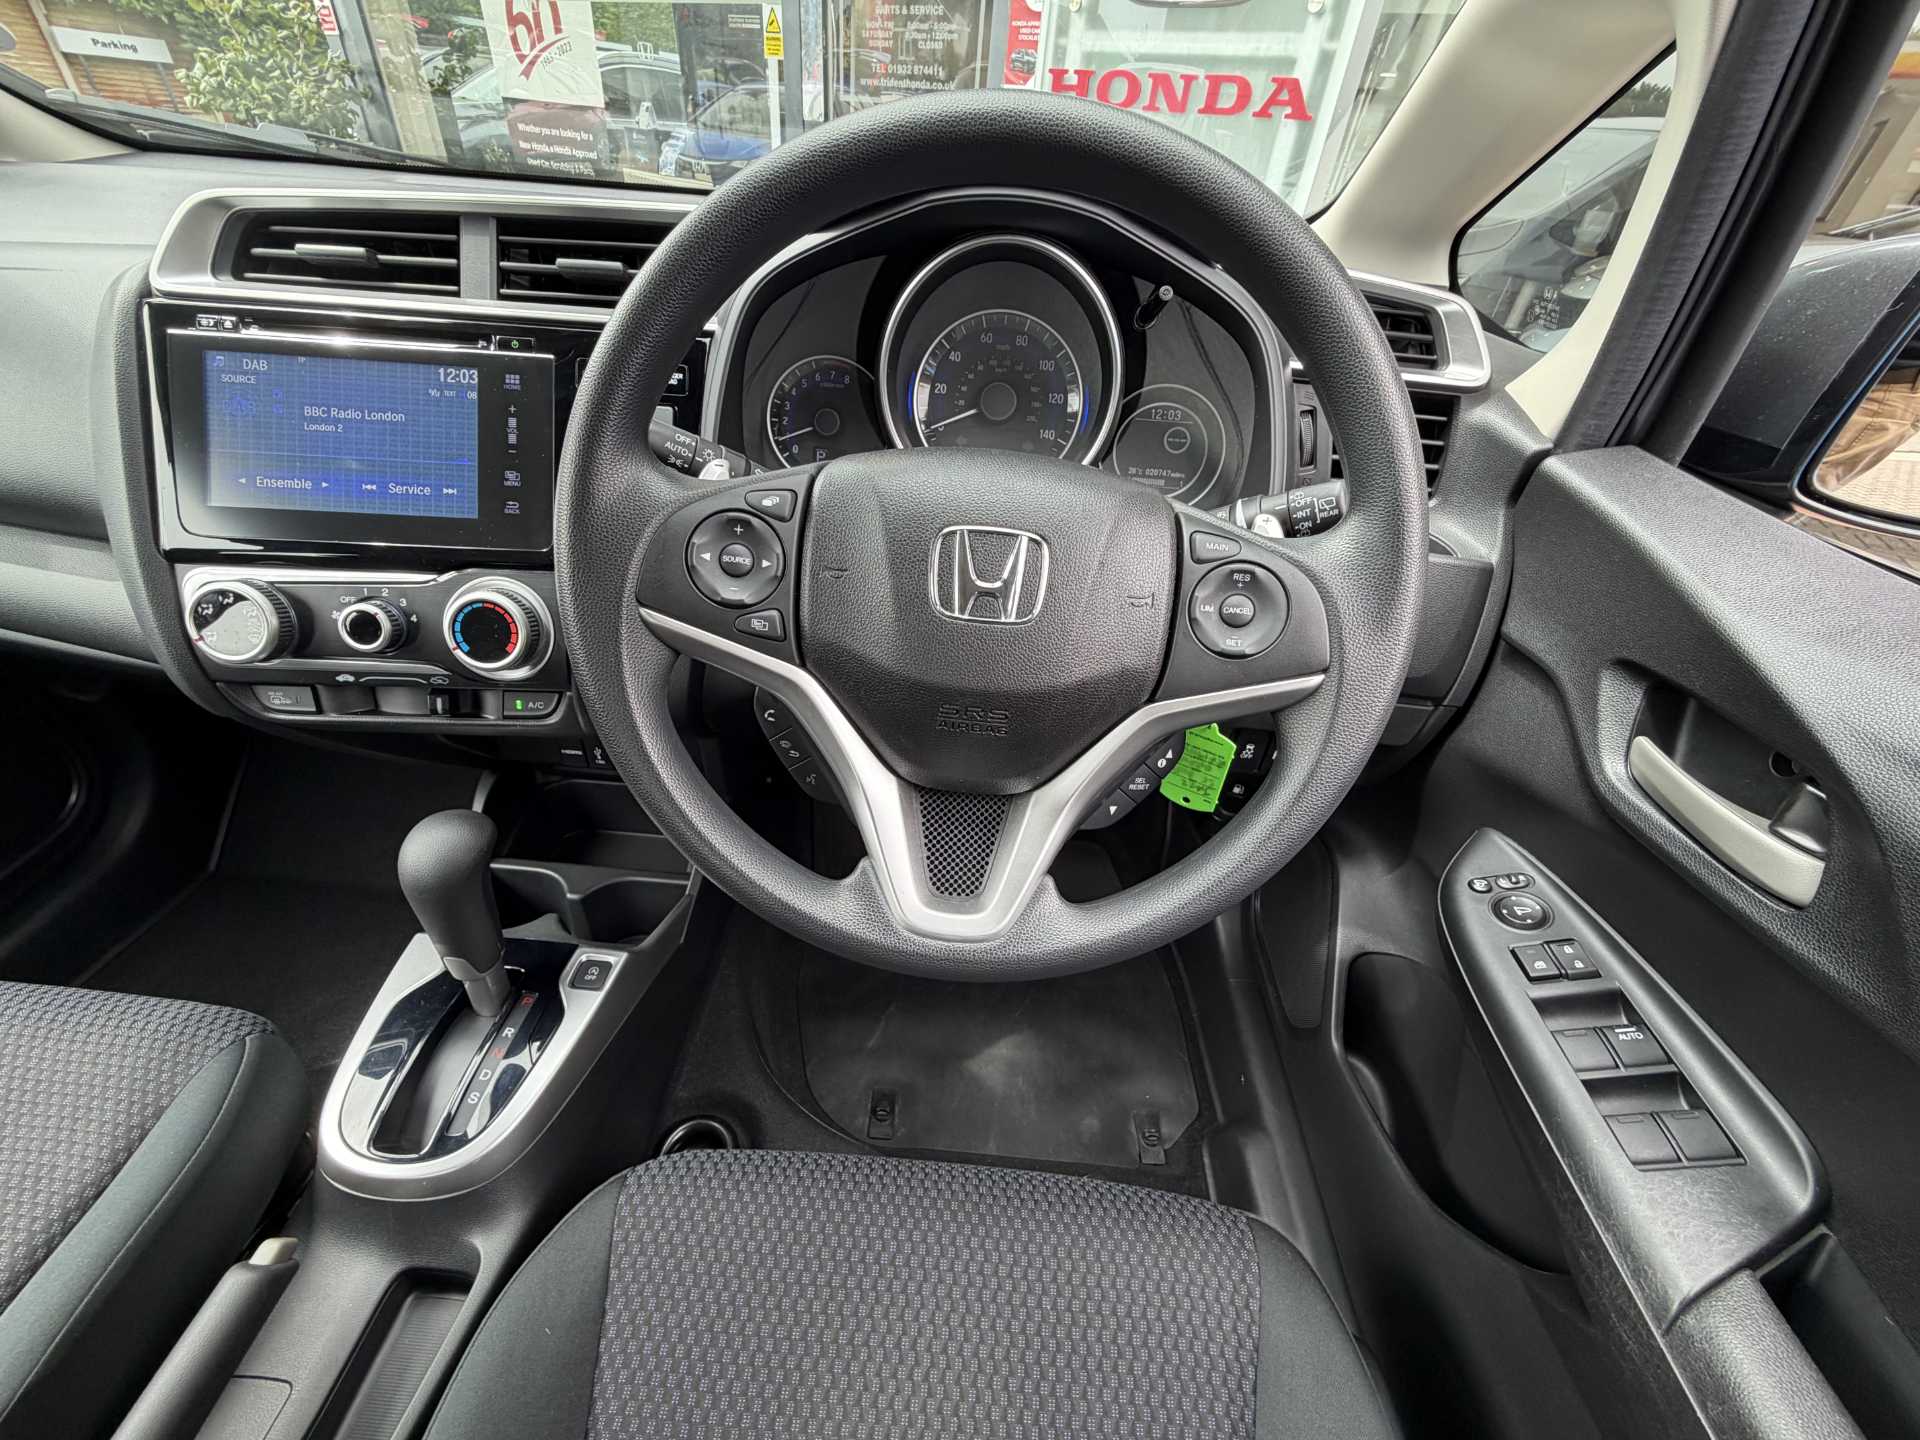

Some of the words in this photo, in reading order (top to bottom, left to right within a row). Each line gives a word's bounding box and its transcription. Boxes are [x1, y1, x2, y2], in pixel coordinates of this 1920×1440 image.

[875, 5, 900, 15] PARTS
[910, 4, 944, 16] SERVICE
[91, 37, 139, 53] Parking
[918, 41, 943, 49] CLOSED
[872, 63, 887, 73] TEL
[1048, 68, 1313, 122] HONDA
[560, 128, 580, 141] looking
[980, 333, 993, 344] 60
[1016, 336, 1028, 346] 80
[948, 351, 961, 362] 40
[242, 358, 269, 371] DAB
[1039, 360, 1055, 371] 100
[221, 373, 257, 385] SOURCE
[438, 367, 479, 384] 12:03
[935, 383, 947, 395] 20
[467, 391, 478, 400] 08
[1048, 393, 1064, 405] 120
[785, 401, 791, 410] 3
[304, 406, 328, 418] BBC
[330, 408, 362, 420] Radio
[365, 410, 406, 423] London
[1151, 408, 1182, 421] 12:03
[782, 416, 789, 425] 2
[304, 422, 336, 432] London
[337, 424, 344, 433] 2
[674, 433, 692, 445] OFF
[1039, 429, 1056, 441] 140
[664, 440, 689, 456] AUTO
[792, 444, 799, 454] 0
[255, 475, 313, 489] Ensemble
[388, 482, 432, 496] Service
[1295, 497, 1313, 507] OFF
[1297, 509, 1312, 519] INT
[1320, 509, 1340, 519] REAR
[1300, 521, 1313, 530] ON
[1206, 542, 1229, 551] MAIN
[722, 554, 753, 567] SOURCE
[1233, 573, 1251, 582] RES
[381, 587, 389, 597] 2
[340, 595, 358, 604] OFF
[400, 598, 407, 607] 3
[1223, 606, 1251, 615] CANCEL
[410, 614, 418, 623] 4
[528, 701, 545, 710] A/C
[938, 704, 1010, 722] SRS
[935, 719, 1010, 737] AIRBAG
[502, 1027, 516, 1038] R
[1618, 1032, 1644, 1041] AUTO
[479, 1069, 492, 1081] D
[467, 1091, 480, 1104] S
